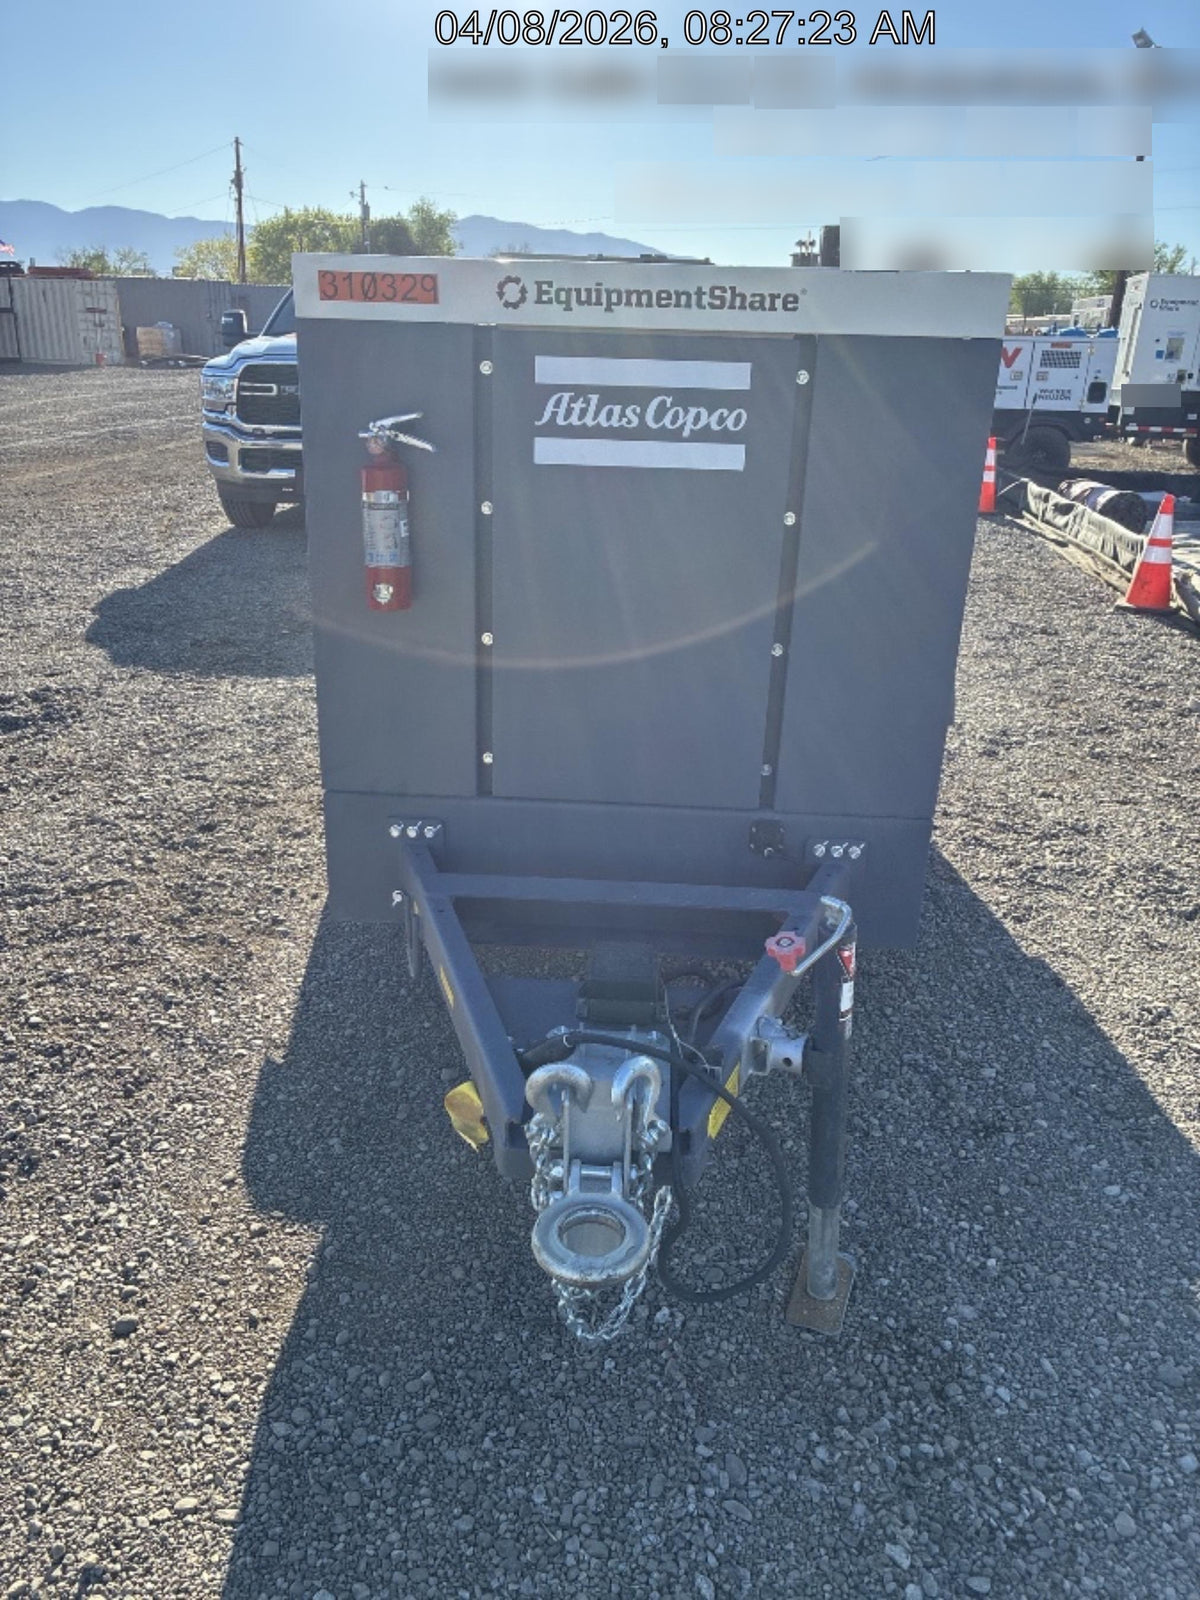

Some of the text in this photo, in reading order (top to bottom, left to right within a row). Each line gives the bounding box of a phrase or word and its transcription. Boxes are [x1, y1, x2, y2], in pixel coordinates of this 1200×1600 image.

[320, 271, 438, 304] 310329
[533, 280, 800, 312] EquipmentShare
[534, 392, 748, 437] Atlas Copco
